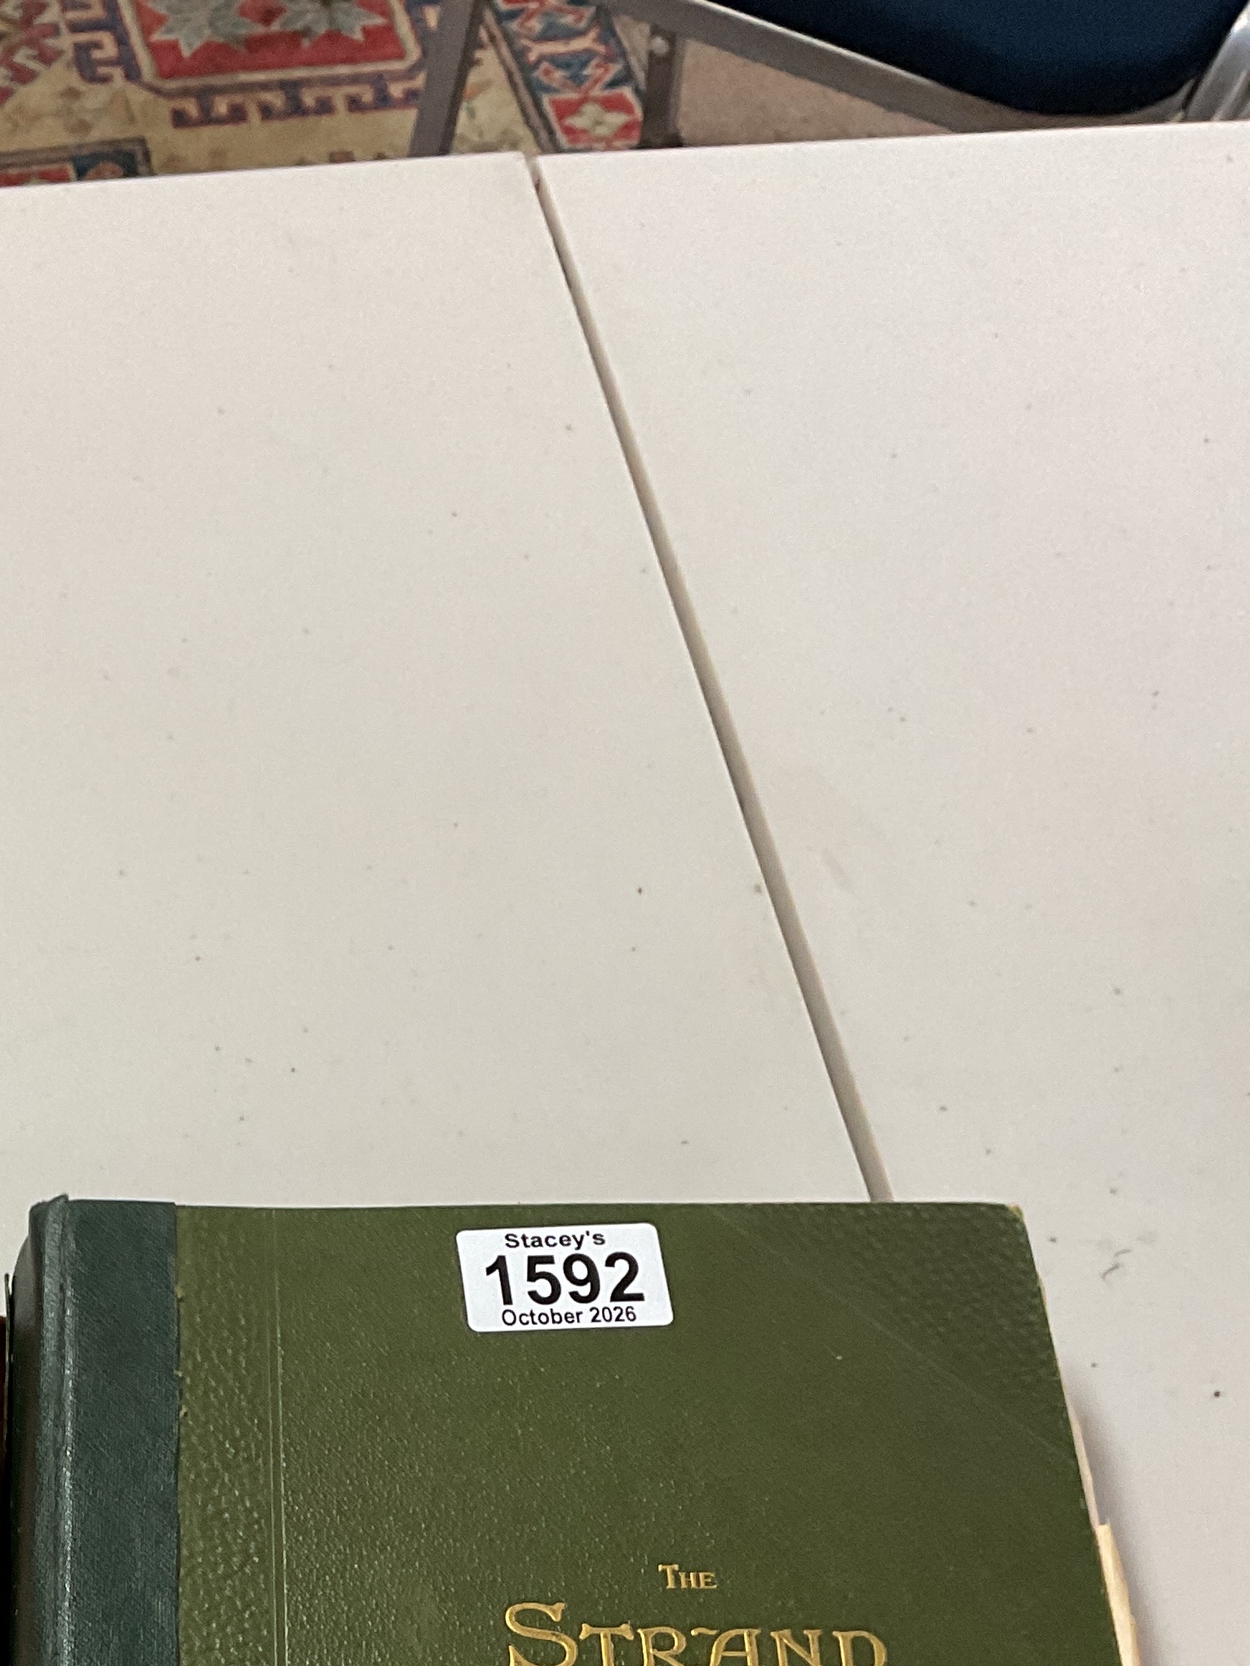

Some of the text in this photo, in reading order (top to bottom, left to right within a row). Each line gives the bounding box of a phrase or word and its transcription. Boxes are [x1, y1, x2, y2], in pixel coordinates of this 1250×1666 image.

[504, 1230, 606, 1250] Stacey's
[485, 1251, 645, 1306] 1592
[501, 1306, 637, 1326] October 2026
[657, 1563, 718, 1590] THE
